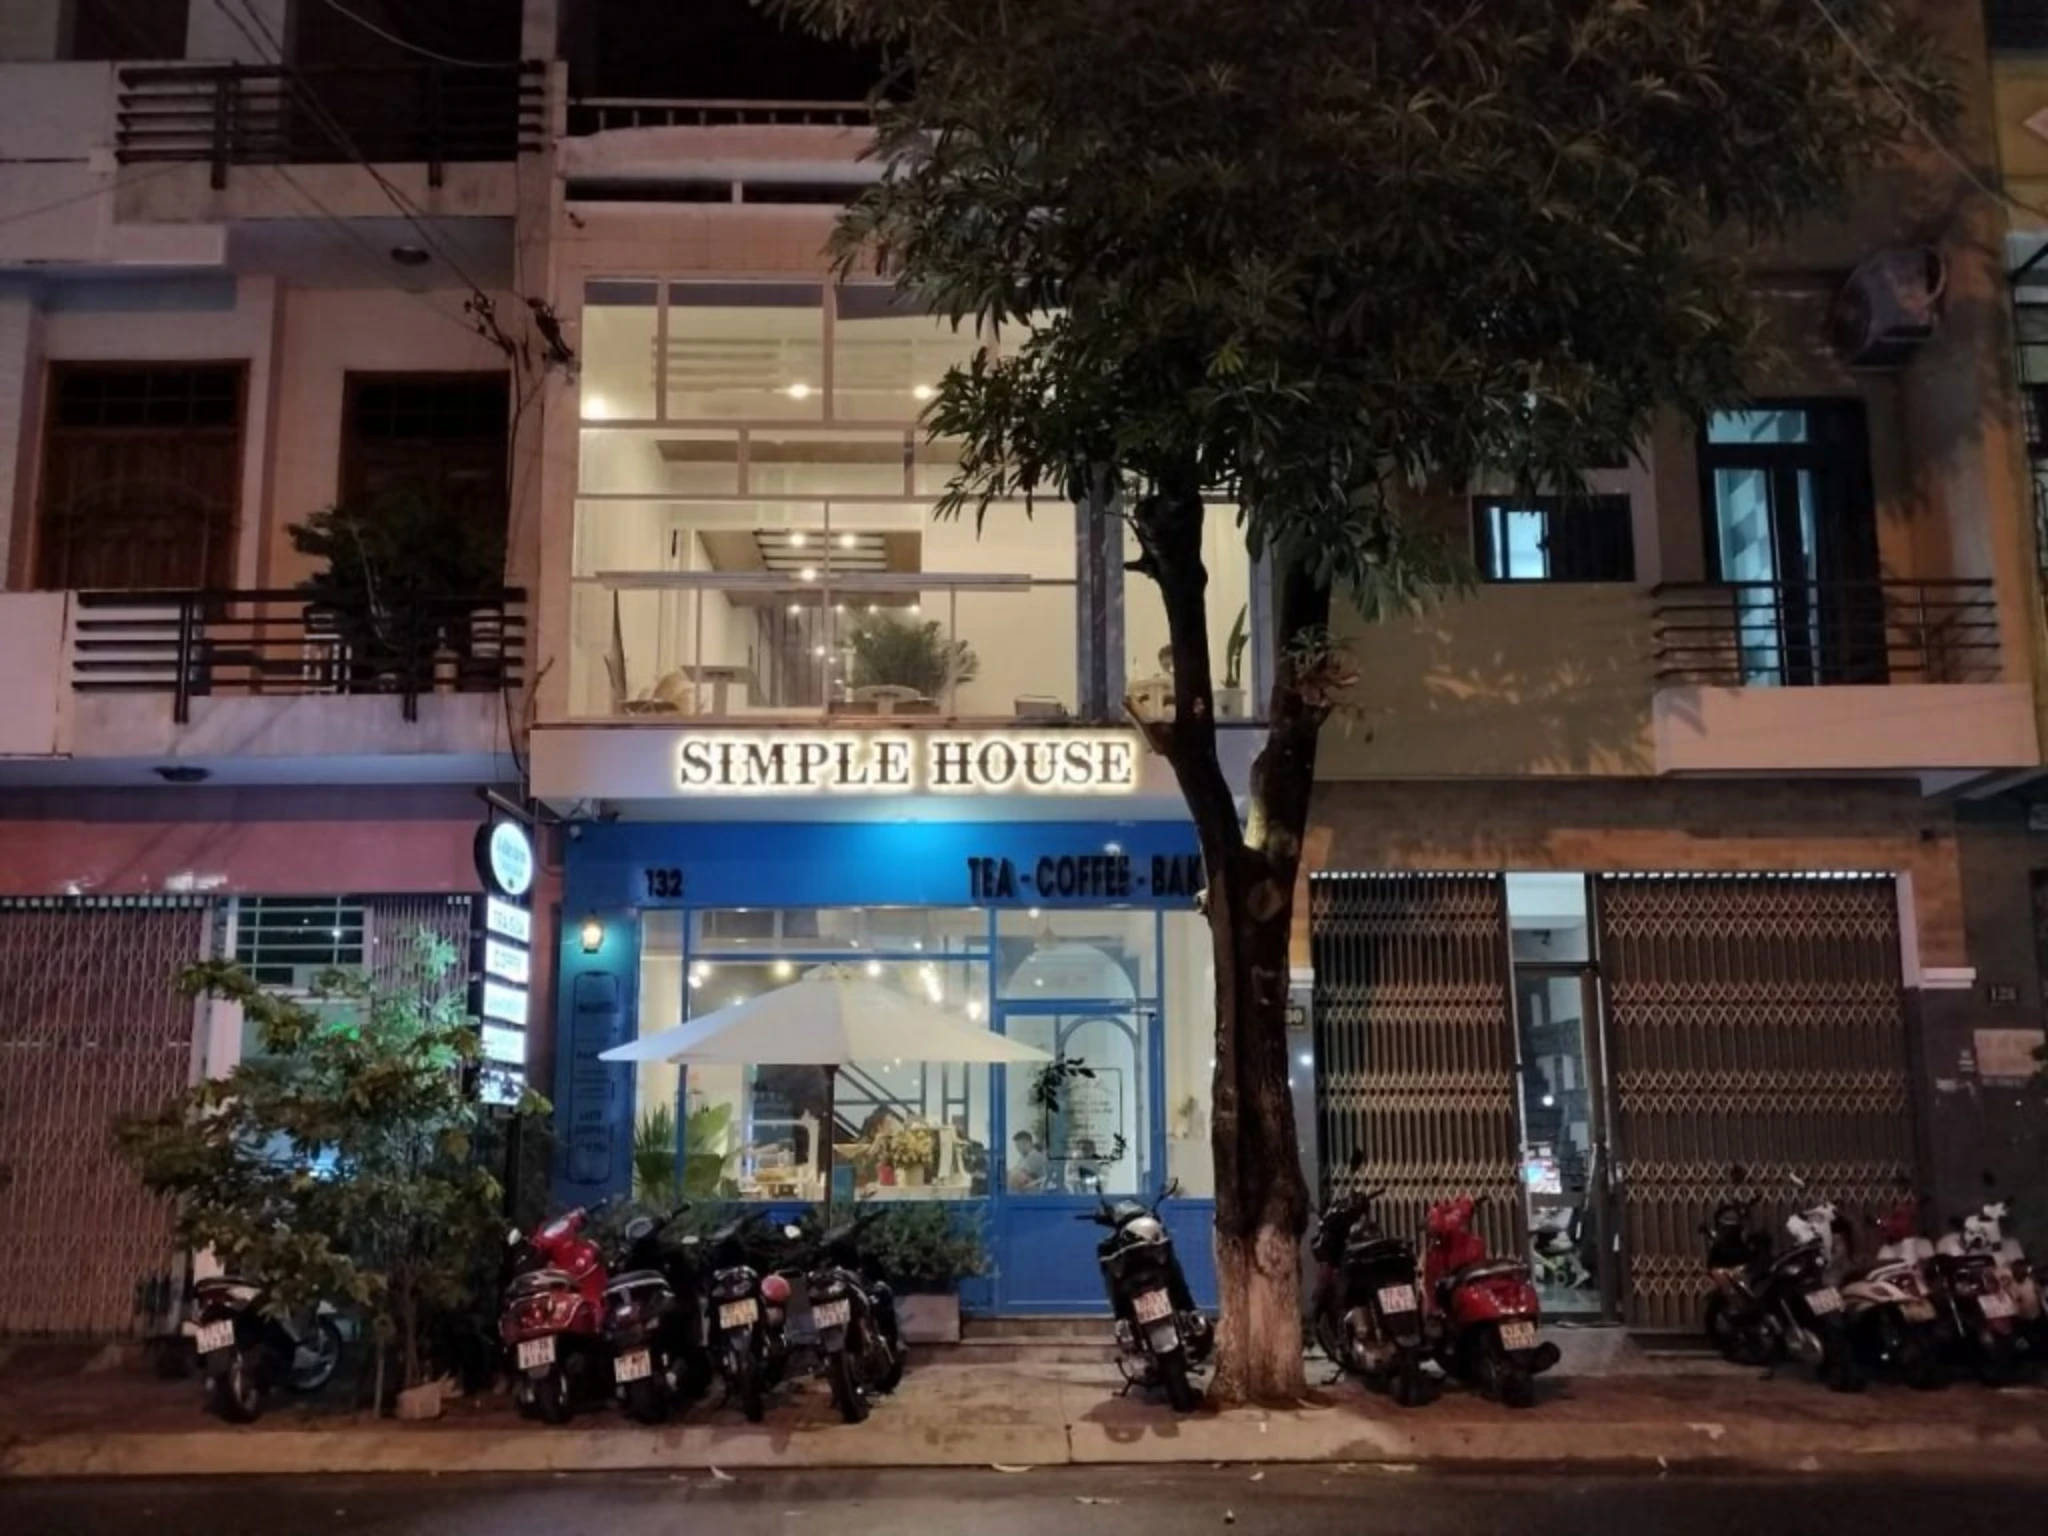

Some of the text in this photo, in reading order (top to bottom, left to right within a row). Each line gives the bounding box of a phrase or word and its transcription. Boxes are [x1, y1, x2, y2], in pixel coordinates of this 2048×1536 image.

[681, 740, 1131, 785] SIMPLE HOUSE
[645, 868, 683, 898] 132
[967, 857, 1014, 898] TEA
[1036, 855, 1131, 898] COFFEE
[1152, 855, 1203, 897] BAK
